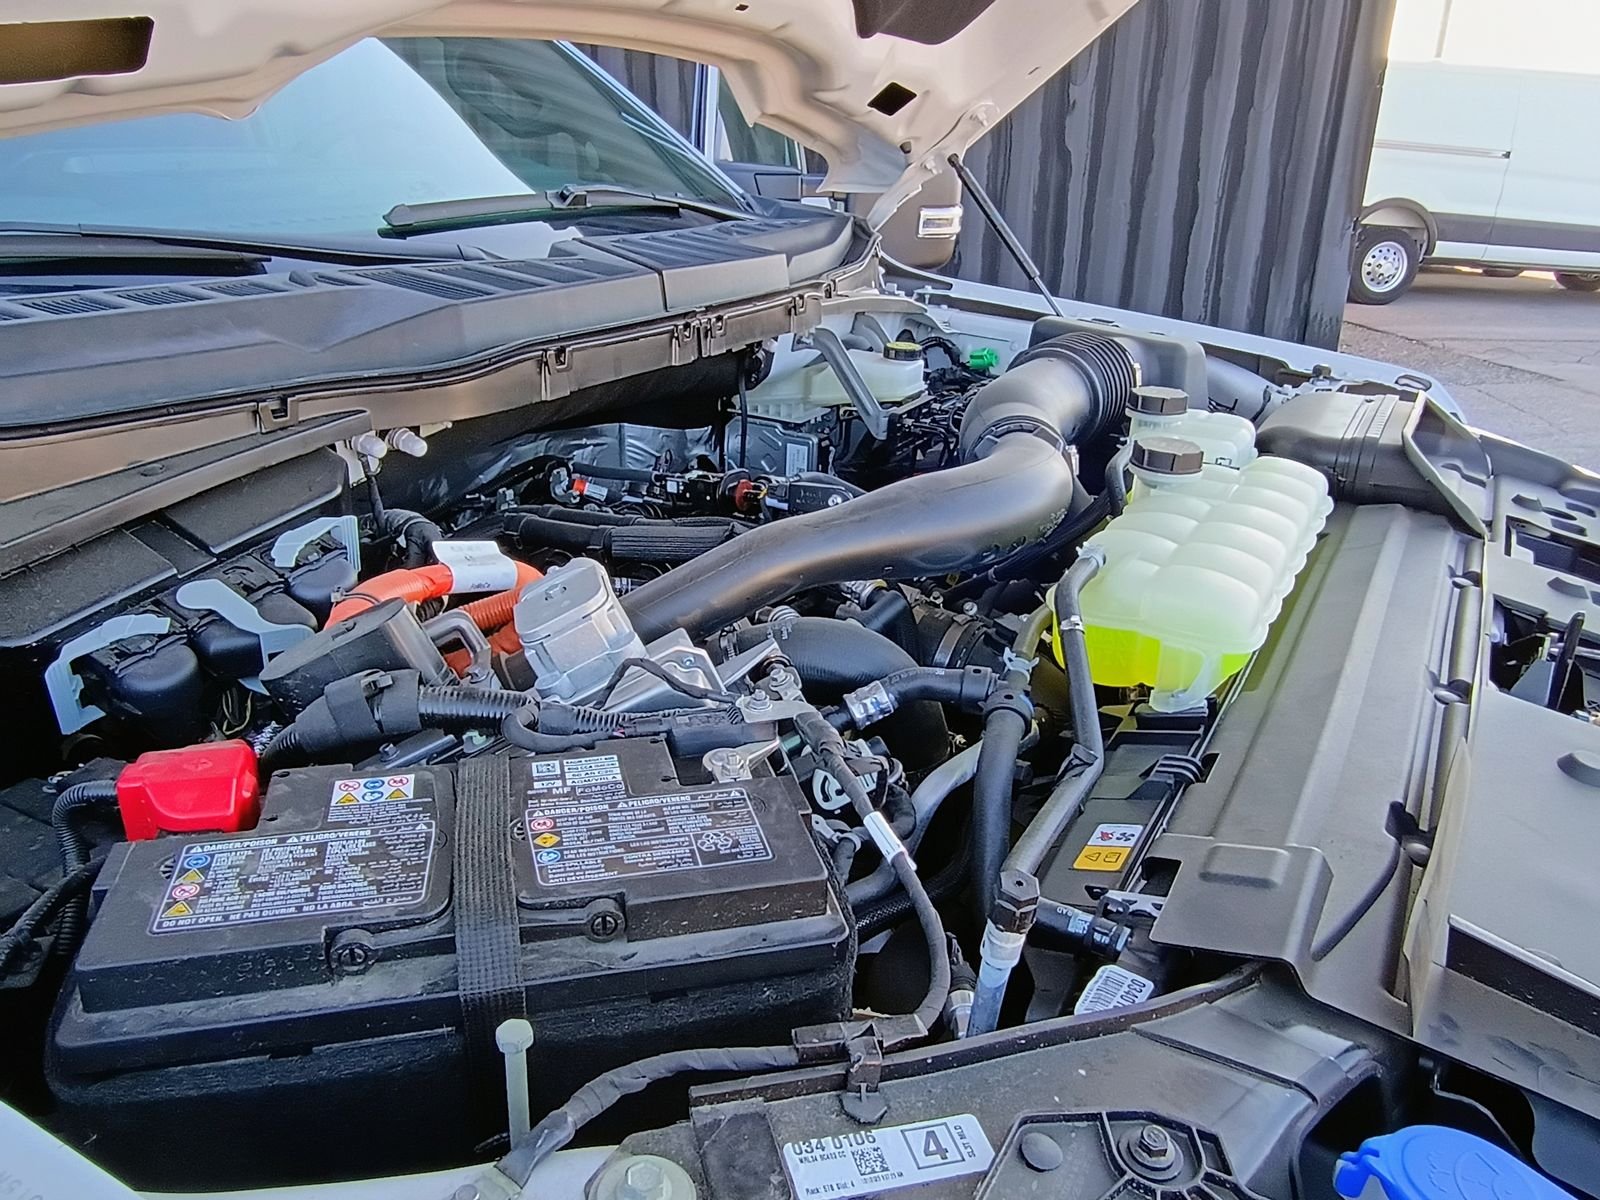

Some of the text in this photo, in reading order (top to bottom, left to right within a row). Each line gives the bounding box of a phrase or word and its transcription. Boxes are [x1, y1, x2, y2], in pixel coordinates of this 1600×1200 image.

[552, 786, 571, 795] MF
[578, 783, 623, 793] FoMoCo
[627, 795, 691, 807] PELIGRO/VENENO
[543, 804, 609, 815] DANGER/POISON
[298, 828, 371, 842] PELIGRO/VENENO
[202, 838, 278, 852] DANGER/POISON
[301, 904, 315, 912] NO
[161, 914, 225, 927] DO NOT OPEN.
[228, 912, 242, 920] NE
[242, 910, 261, 919] PAS
[791, 1138, 825, 1156] 034
[923, 1129, 949, 1161] 4
